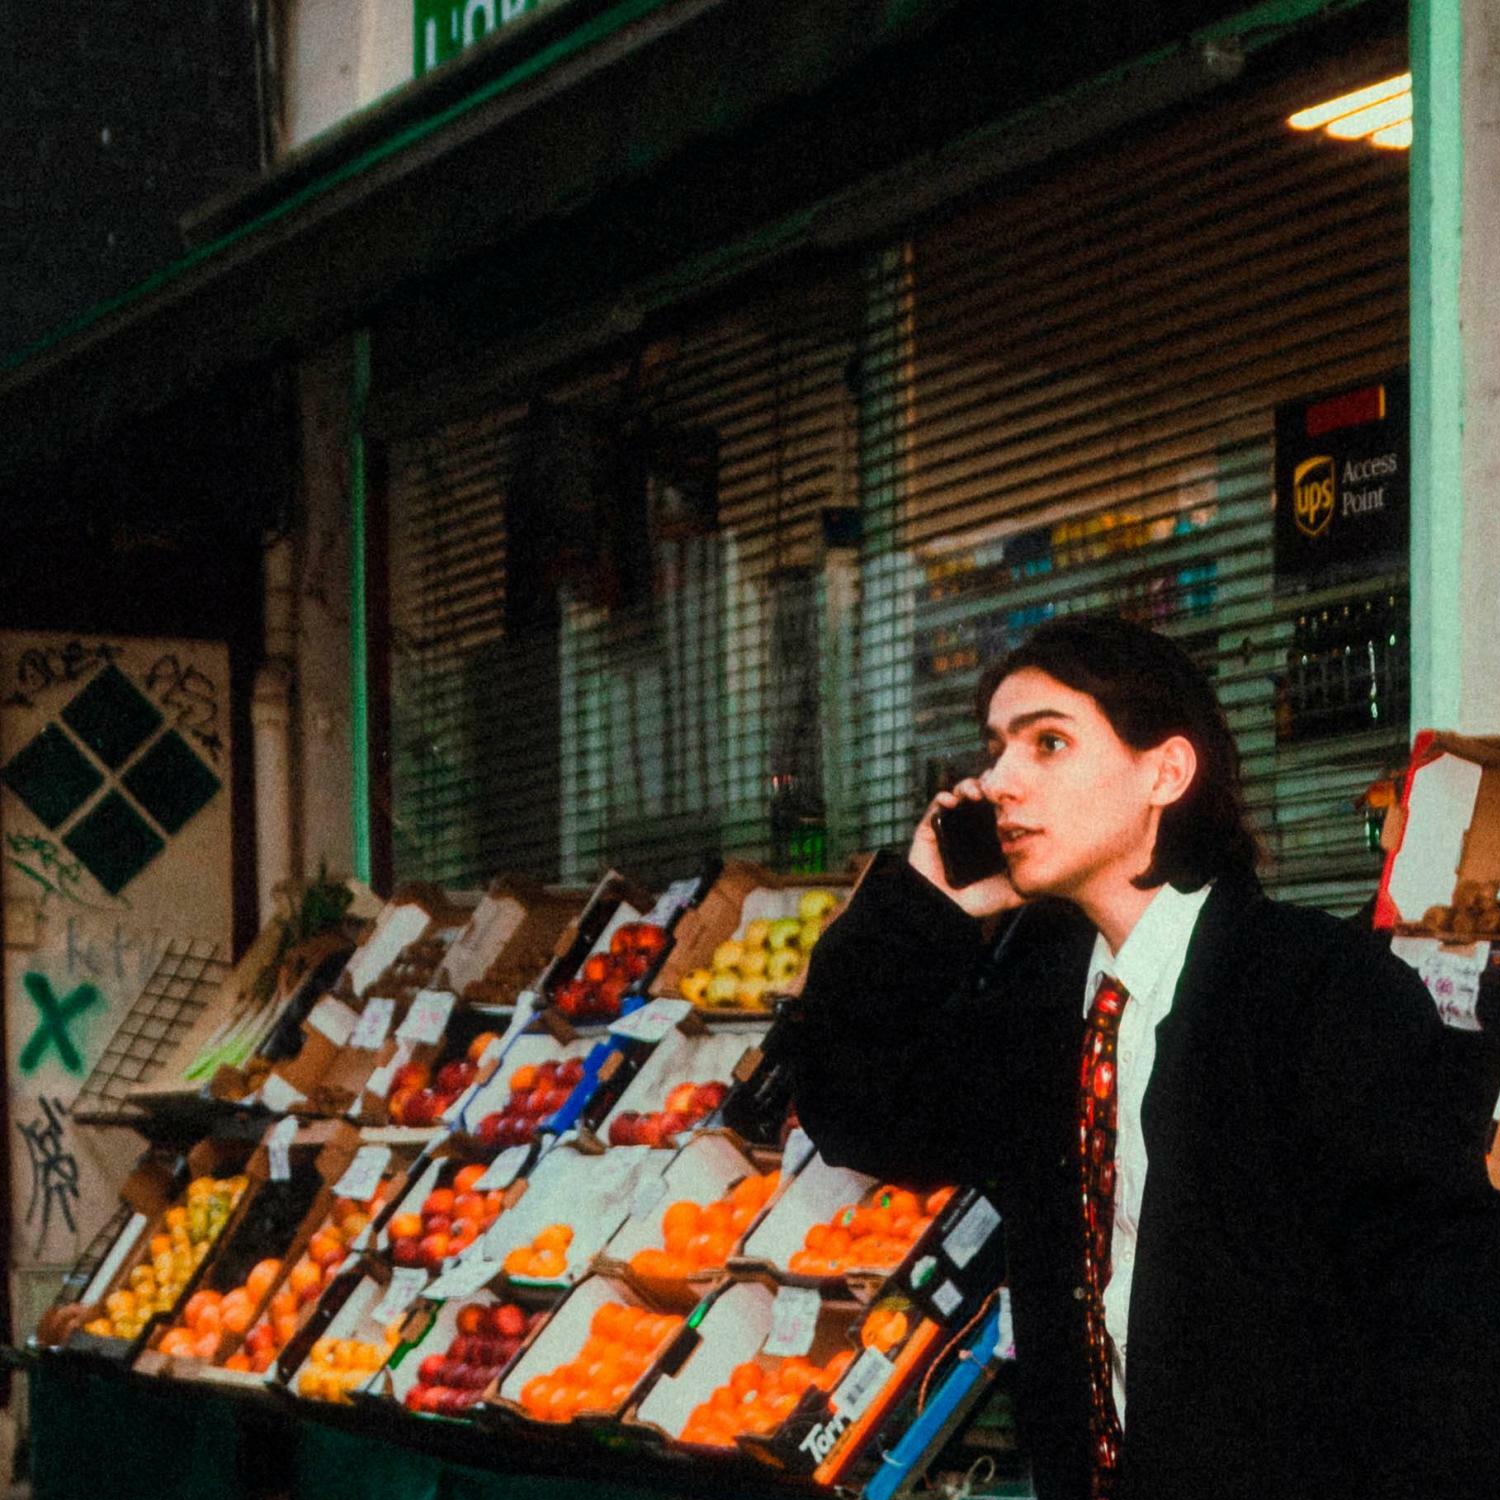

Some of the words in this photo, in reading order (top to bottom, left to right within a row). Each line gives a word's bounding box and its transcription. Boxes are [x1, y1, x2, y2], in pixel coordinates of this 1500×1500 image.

[1342, 452, 1398, 484] Access
[1298, 478, 1332, 524] ups
[1342, 486, 1385, 517] Point
